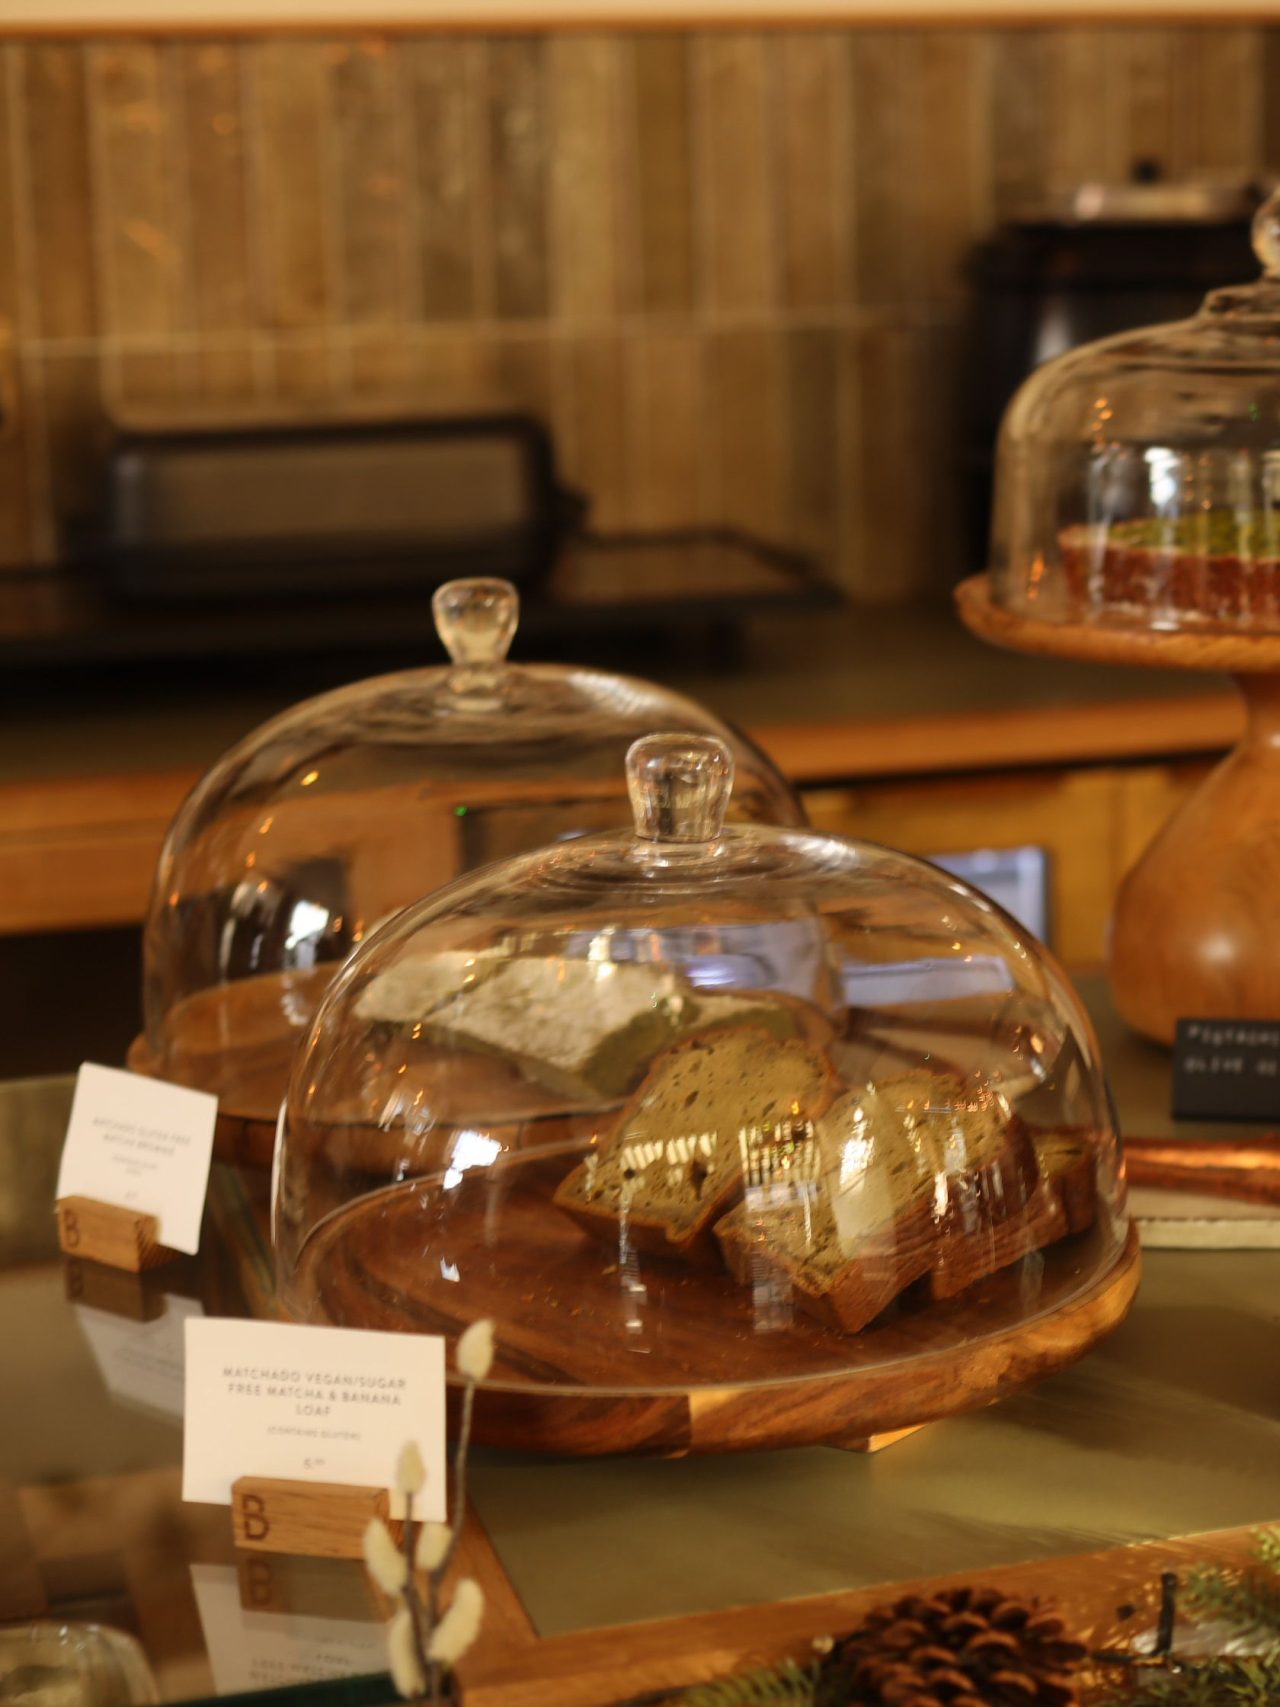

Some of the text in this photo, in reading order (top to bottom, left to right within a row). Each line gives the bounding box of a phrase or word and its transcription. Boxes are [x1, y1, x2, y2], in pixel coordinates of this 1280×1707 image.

[223, 1367, 407, 1390] MATCHADO VEGAN/SUGAR
[228, 1383, 261, 1396] FREE
[267, 1385, 323, 1401] MATCHA
[341, 1391, 401, 1406] BANANA
[296, 1404, 331, 1417] LOAF
[241, 1493, 270, 1541] B
